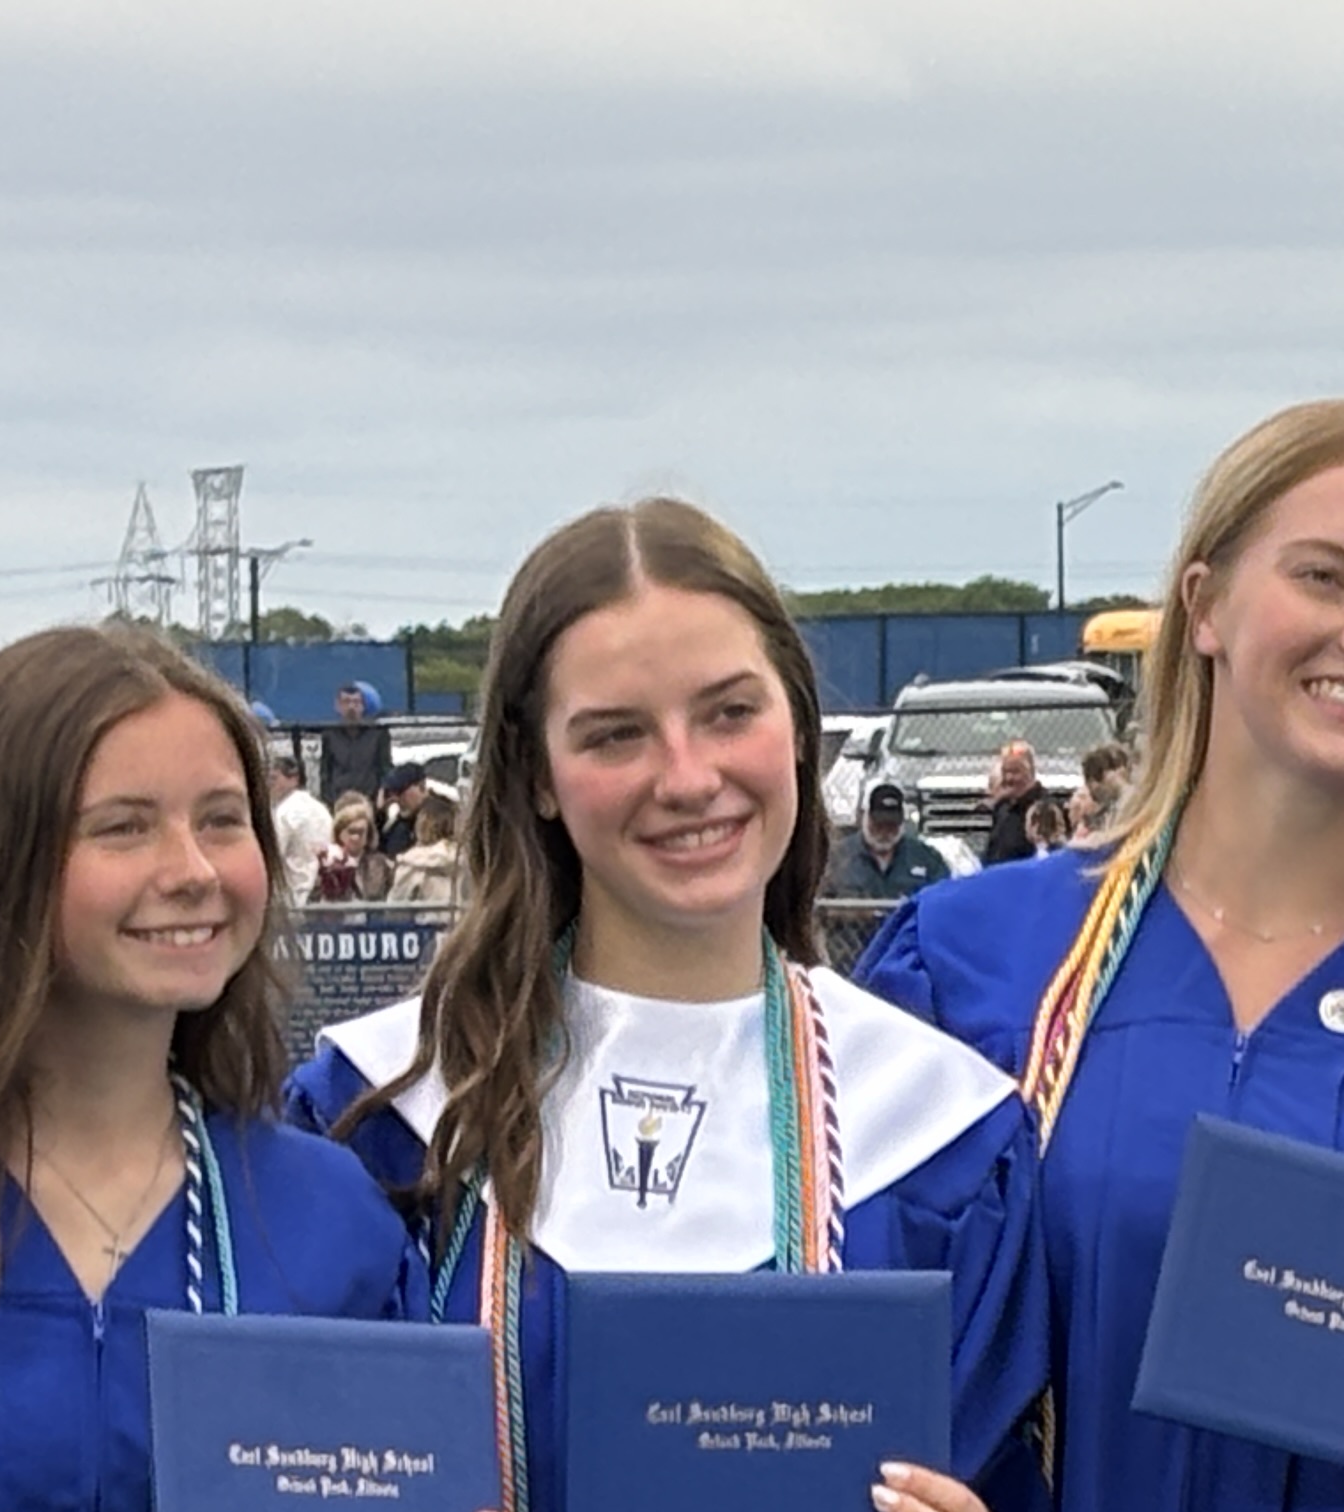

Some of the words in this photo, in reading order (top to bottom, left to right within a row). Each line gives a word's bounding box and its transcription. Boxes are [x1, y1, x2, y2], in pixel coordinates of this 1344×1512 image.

[273, 933, 420, 961] ANDBURG
[1244, 1259, 1276, 1285] Carl
[647, 1401, 681, 1424] Carl
[770, 1401, 810, 1428] High
[816, 1402, 873, 1427] School
[229, 1443, 260, 1465] Carl
[341, 1446, 378, 1475] High
[382, 1449, 434, 1477] School
